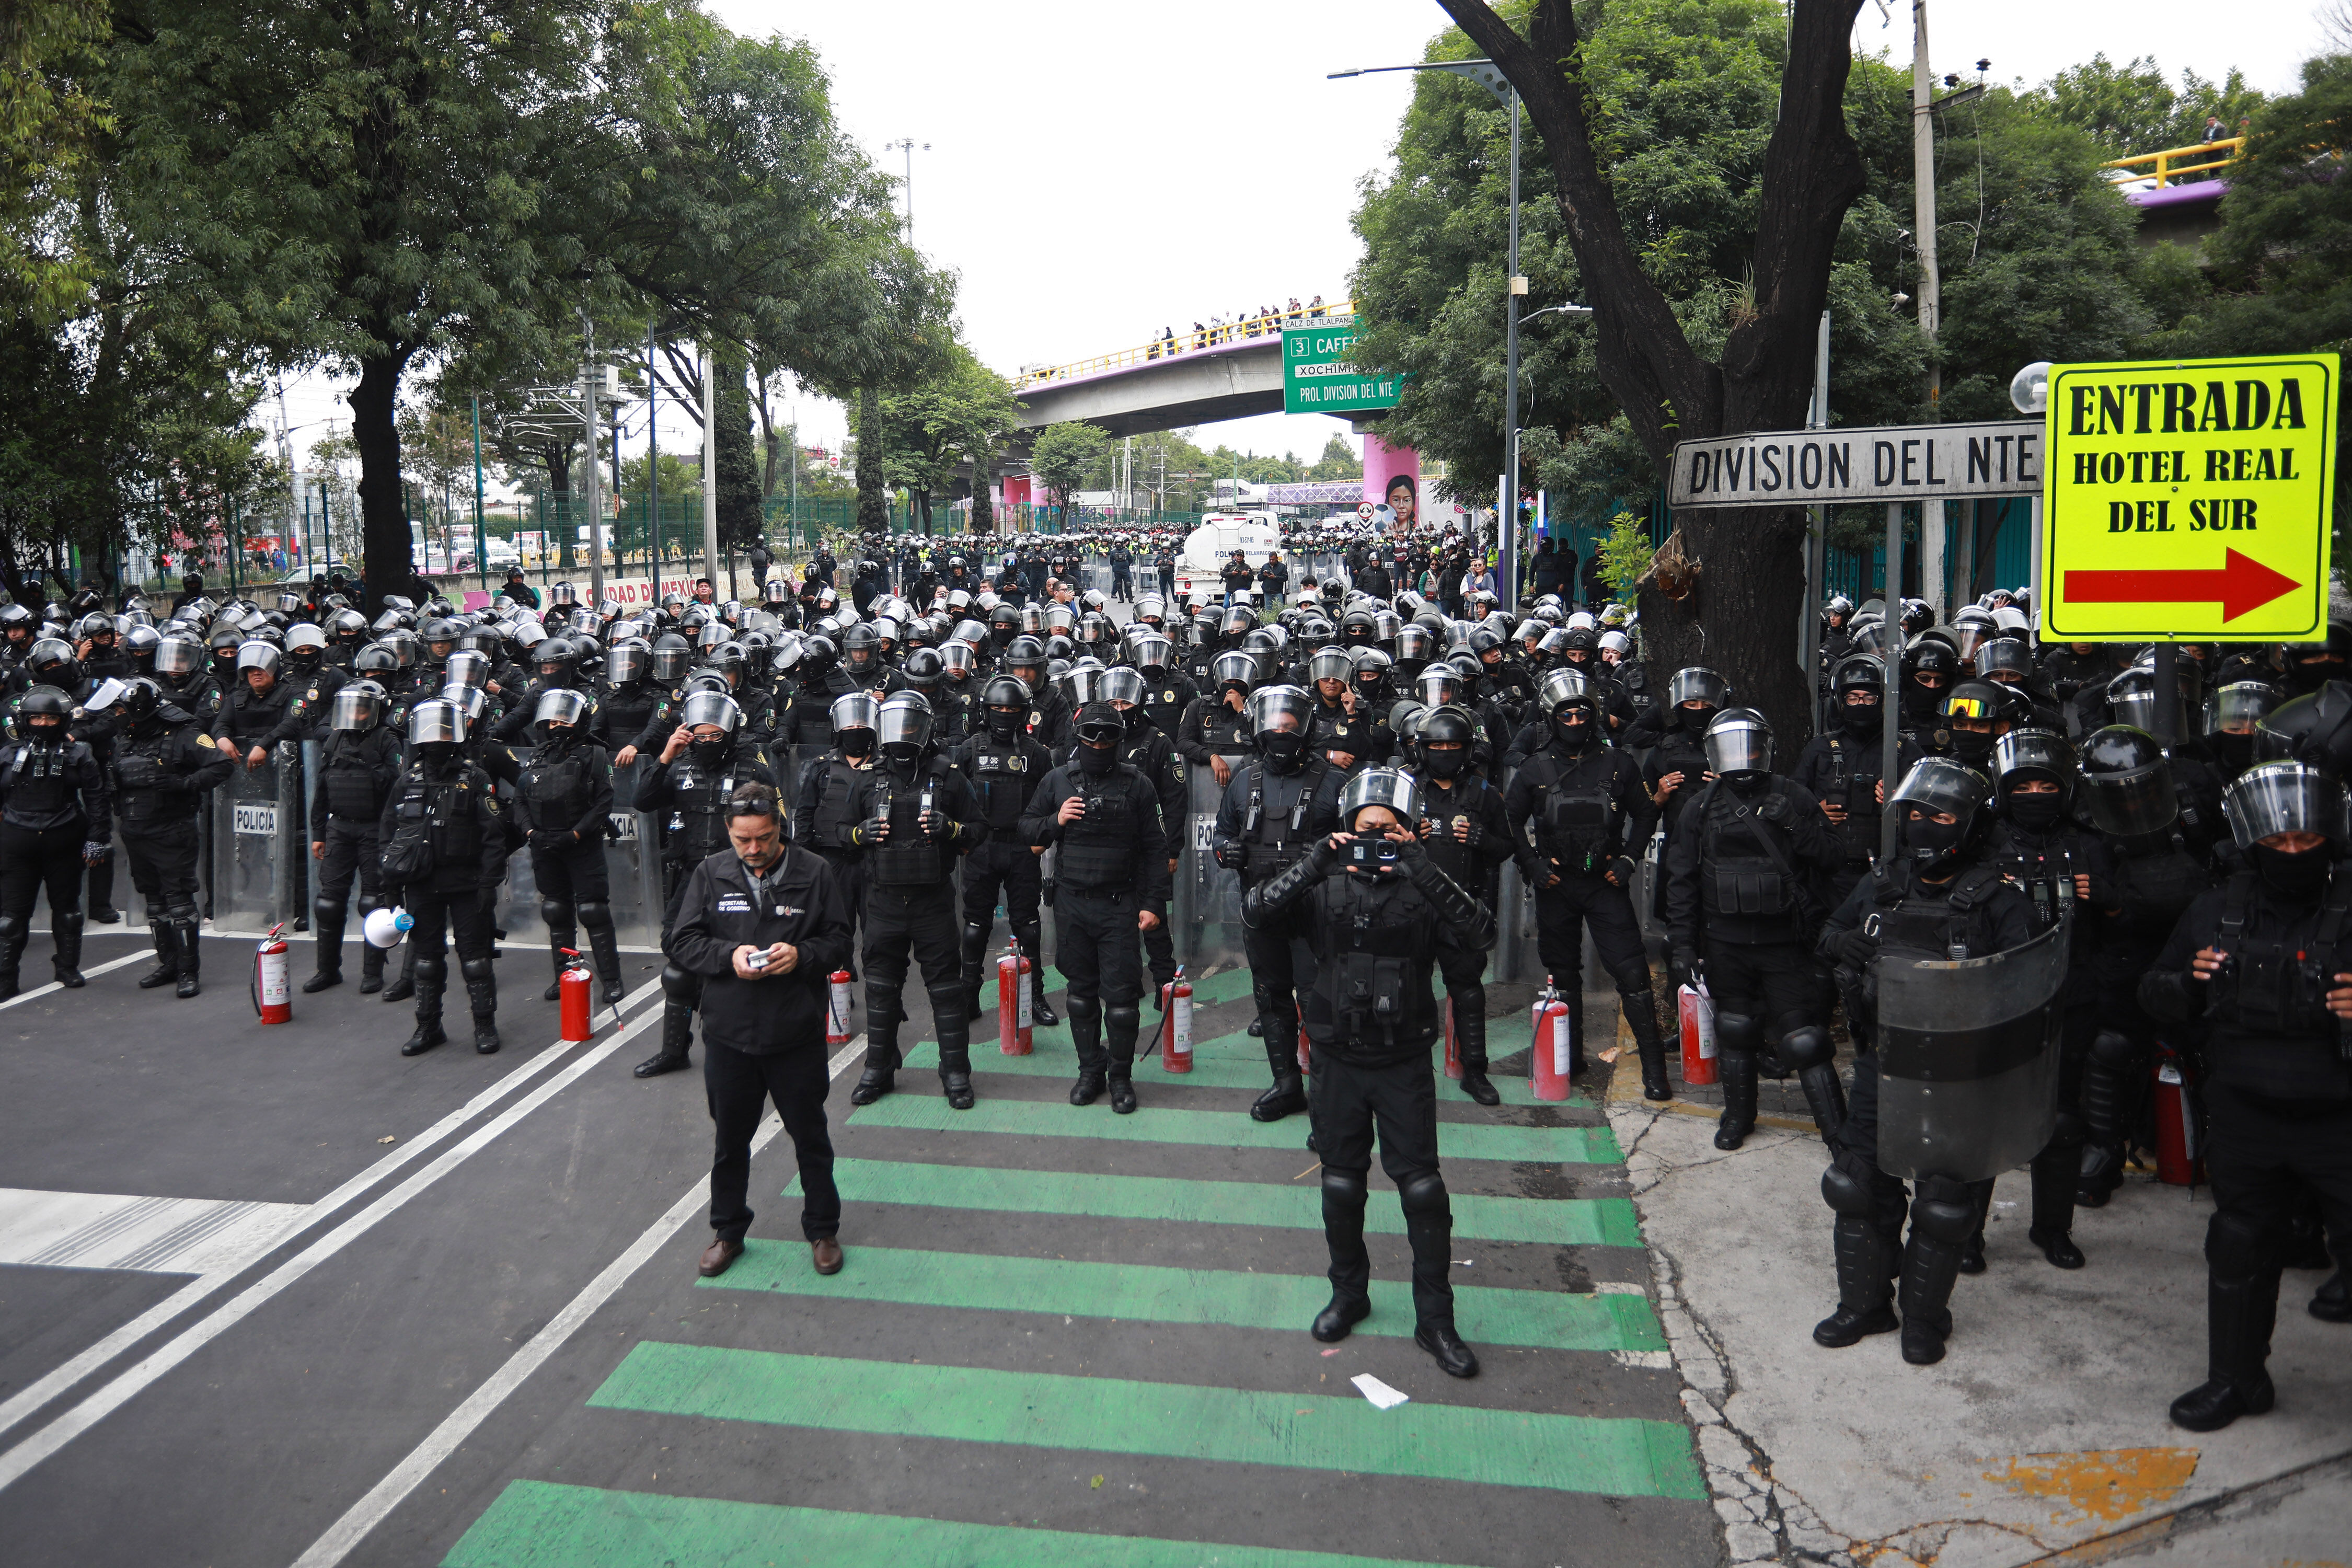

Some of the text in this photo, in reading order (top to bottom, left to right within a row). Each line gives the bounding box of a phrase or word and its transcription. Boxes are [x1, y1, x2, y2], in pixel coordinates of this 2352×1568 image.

[1319, 317, 1348, 326] TLALPAN
[1296, 342, 1304, 352] 3
[1300, 382, 1393, 402] PROL DIVISION DEL NTE
[2068, 378, 2306, 435] ENTRADA
[1689, 434, 2039, 494] DIVISION DEL NTE
[2073, 448, 2299, 485] HOTEL REAL
[2108, 499, 2257, 533] DEL SUR
[661, 577, 697, 598] MÉXIC
[237, 810, 275, 832] POLICIA
